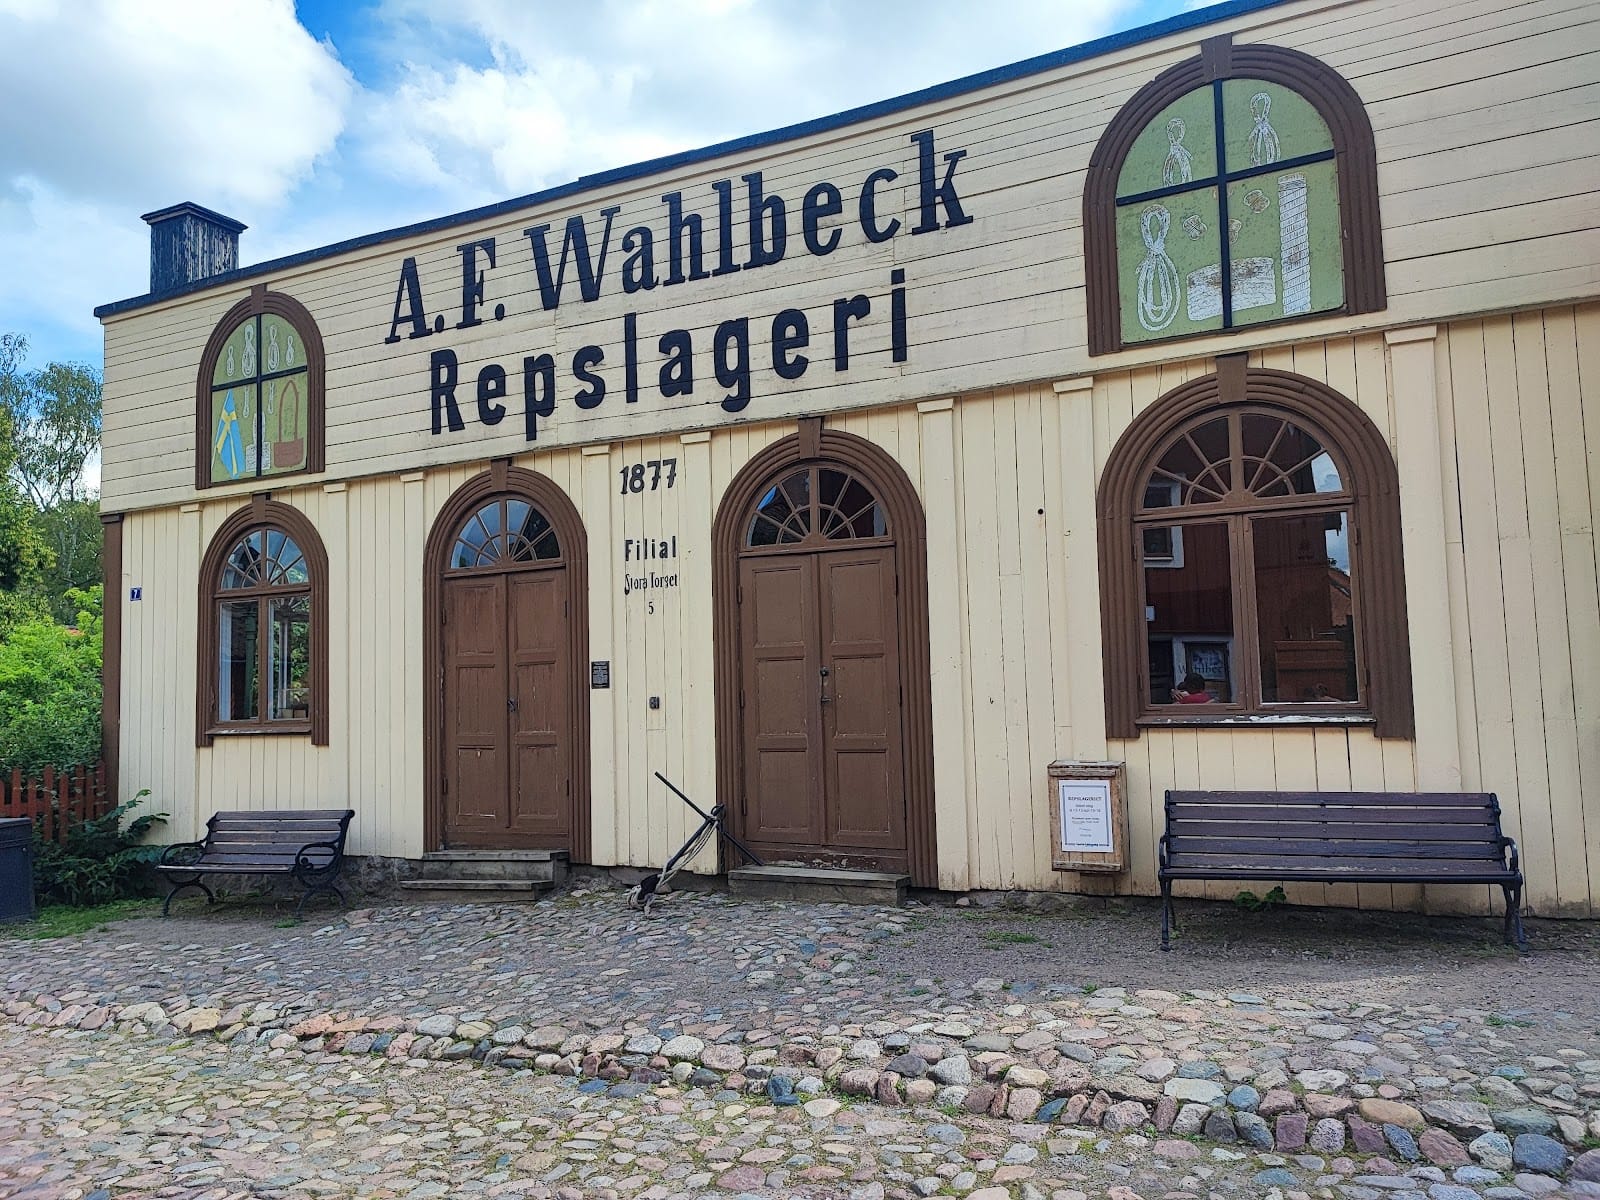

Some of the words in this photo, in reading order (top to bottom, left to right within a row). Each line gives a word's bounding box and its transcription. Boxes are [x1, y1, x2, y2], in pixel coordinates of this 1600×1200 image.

[429, 268, 907, 441] Repslageri
[619, 458, 677, 495] 1877
[625, 535, 677, 562] Filial
[624, 573, 648, 595] Stora
[650, 572, 678, 589] Torget
[648, 601, 654, 615] 5
